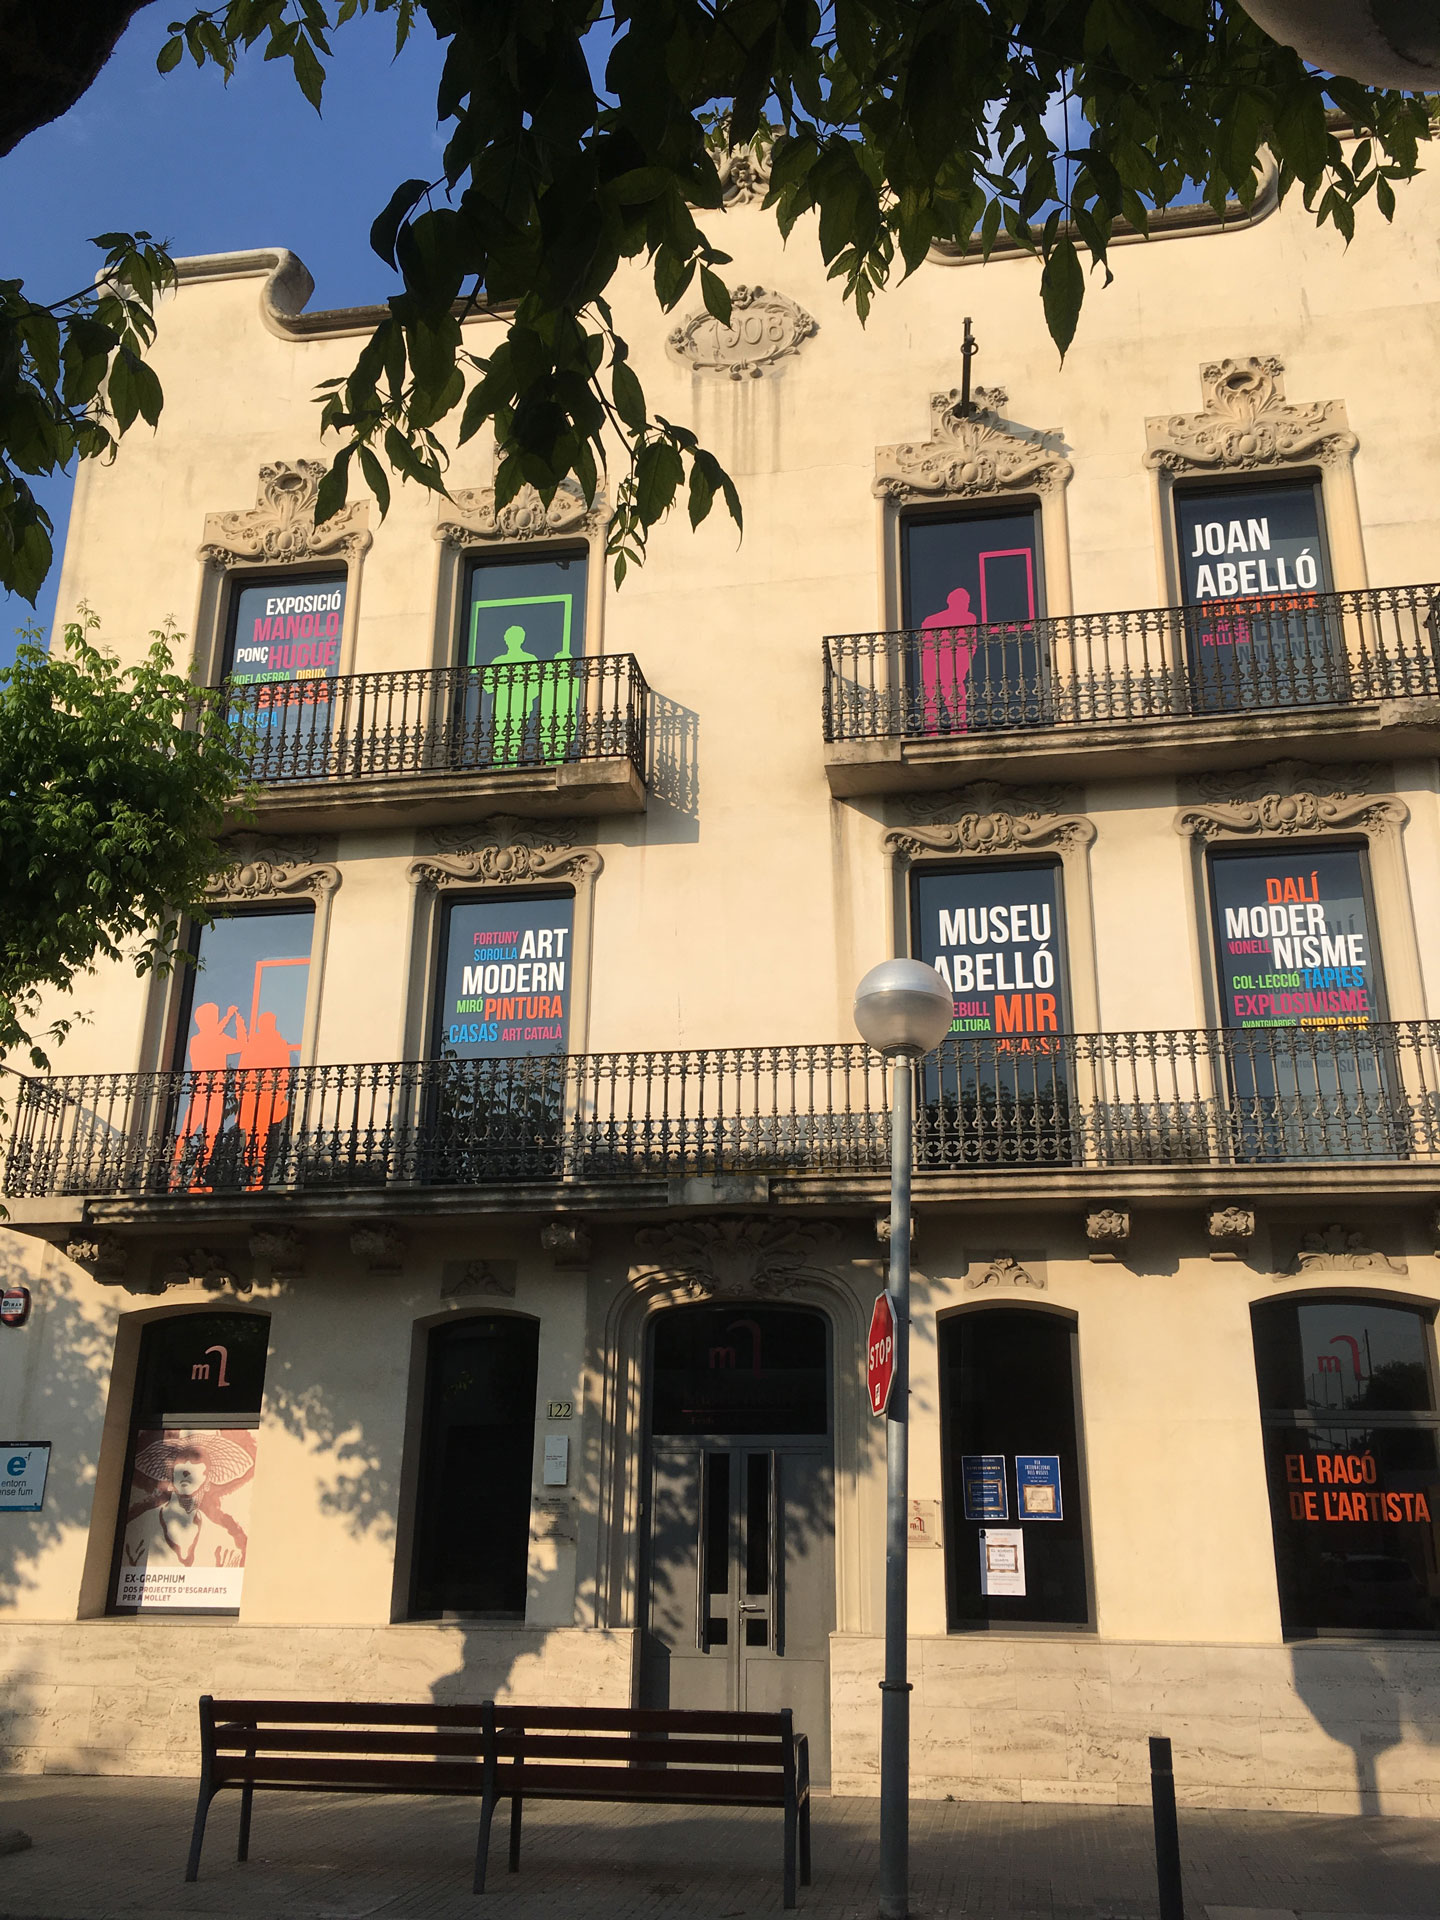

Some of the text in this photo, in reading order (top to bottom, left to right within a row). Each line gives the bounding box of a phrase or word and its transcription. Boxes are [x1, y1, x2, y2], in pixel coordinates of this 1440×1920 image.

[1191, 518, 1271, 557] JOAN
[1196, 548, 1318, 598] ABELLÓ
[266, 590, 341, 616] EXPOSICIÓ
[253, 612, 339, 642] MANOLO
[236, 647, 269, 664] PONÇ
[268, 638, 337, 670] HUGUÉ
[1266, 871, 1319, 904] DALÍ
[939, 904, 1050, 946] MUSEU
[1225, 904, 1327, 939] MODER
[473, 931, 519, 945] FORTUNY
[520, 929, 568, 959] ART
[1227, 940, 1272, 954] NONELL
[474, 947, 517, 961] SOROLLA
[1273, 934, 1366, 969] NISME
[462, 962, 565, 995] MODERN
[934, 943, 1054, 992] ABELLÓ
[1301, 966, 1364, 989] TÀPIES
[456, 997, 484, 1013] MIRÓ
[485, 996, 563, 1021] PINTURA
[953, 1001, 990, 1017] EBULL
[994, 993, 1057, 1033] MIR
[1234, 990, 1369, 1016] EXPLOSIVISME
[449, 1023, 498, 1043] CASAS
[502, 1024, 562, 1041] ART CATALÀ
[870, 1336, 891, 1371] STOP
[549, 1403, 571, 1418] 122
[1285, 1450, 1377, 1484] EL RACÓ
[1, 1480, 26, 1488] entorn
[18, 1487, 33, 1496] fum
[1289, 1491, 1431, 1523] DE L'ARTISTA
[125, 1574, 186, 1583] EX-GRAPHIUM
[139, 1586, 177, 1594] PROJECTES
[144, 1594, 171, 1602] MOLLET
